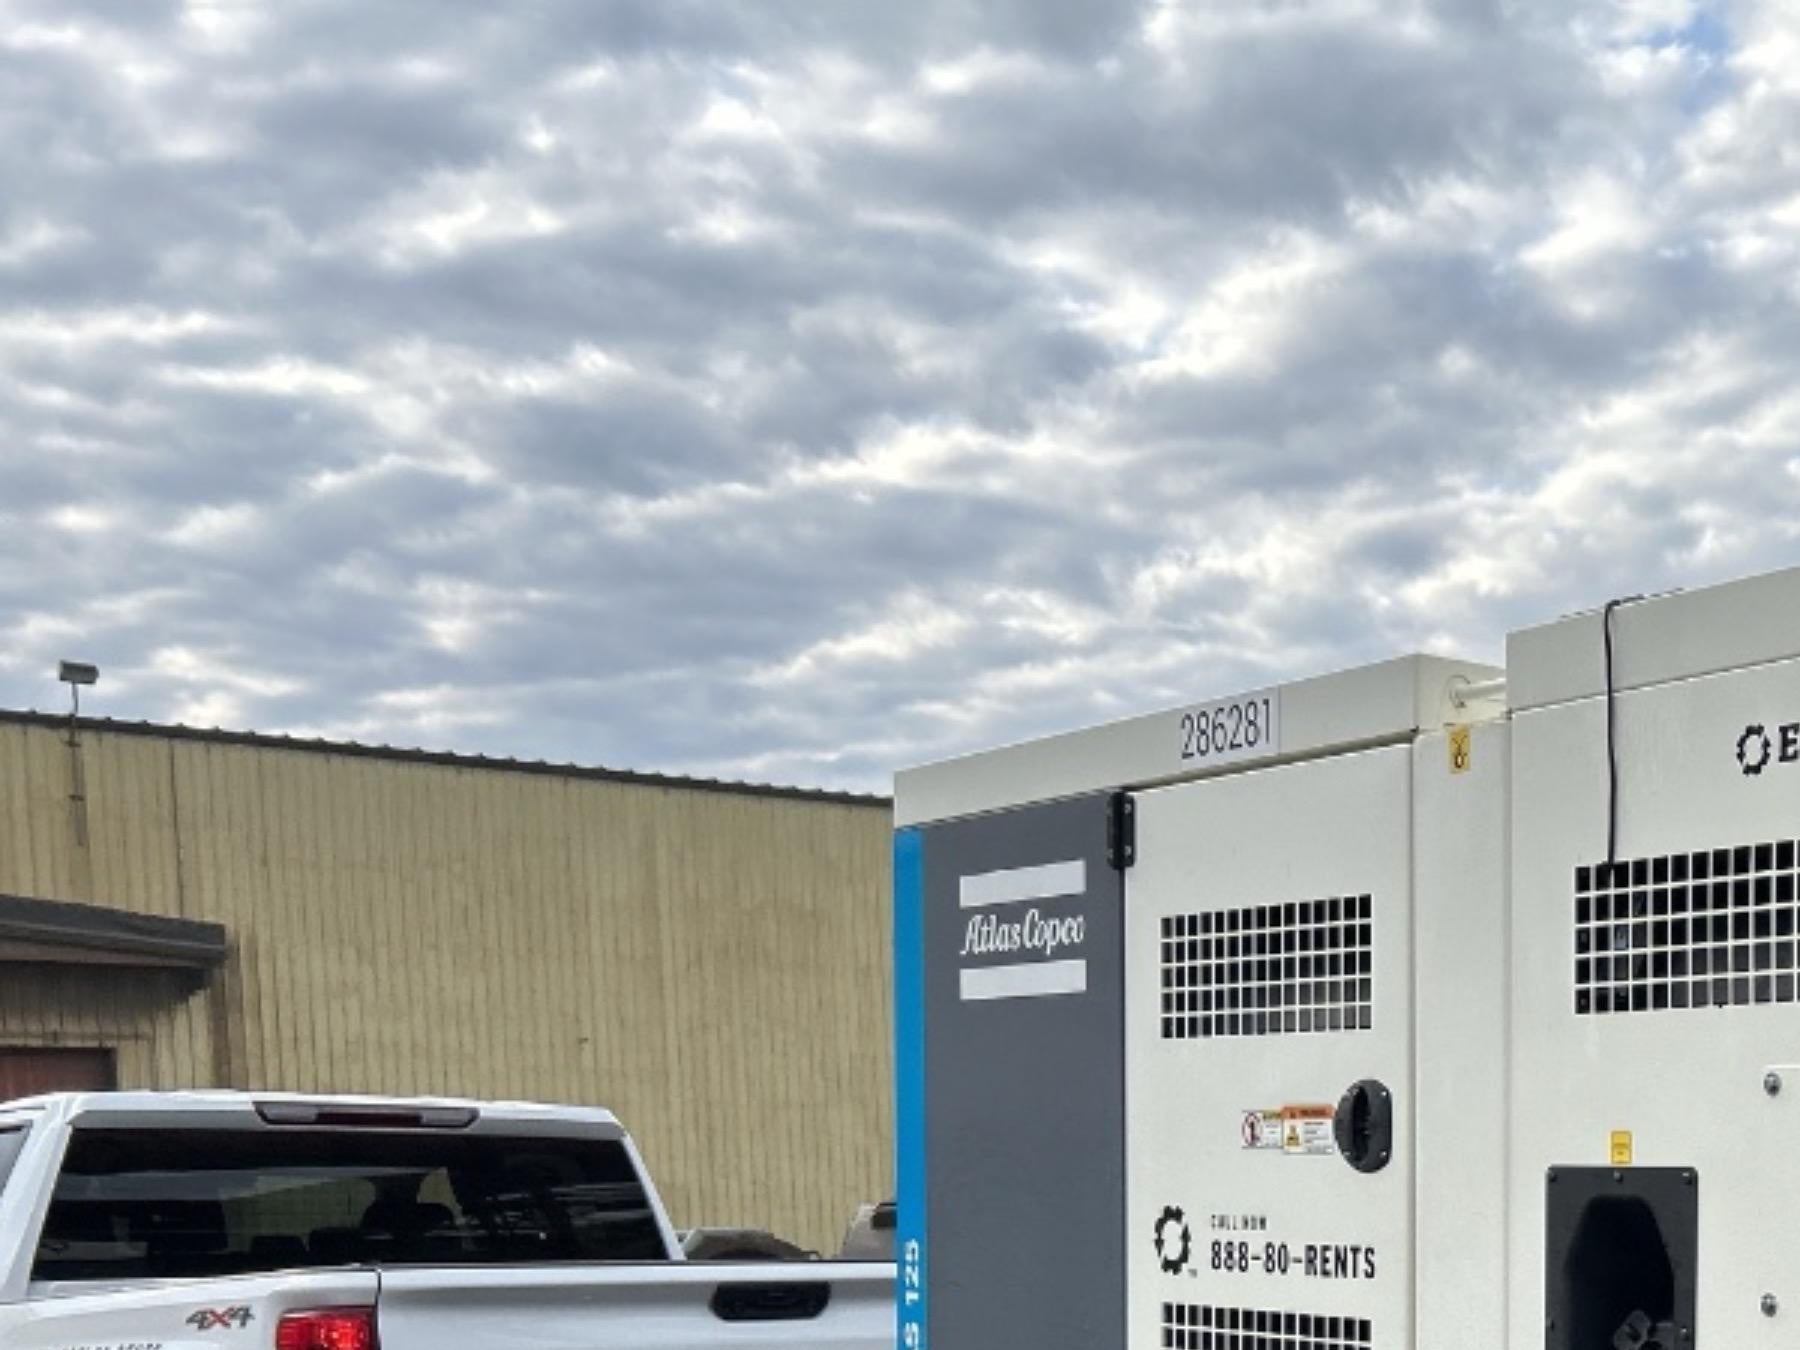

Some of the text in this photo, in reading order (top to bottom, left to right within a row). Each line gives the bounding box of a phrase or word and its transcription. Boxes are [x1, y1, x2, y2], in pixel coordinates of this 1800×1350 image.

[1180, 698, 1270, 759] 286281
[959, 908, 1086, 956] Atlas Copco
[904, 1237, 920, 1307] 125
[1211, 1240, 1376, 1279] 888-80-RENTS
